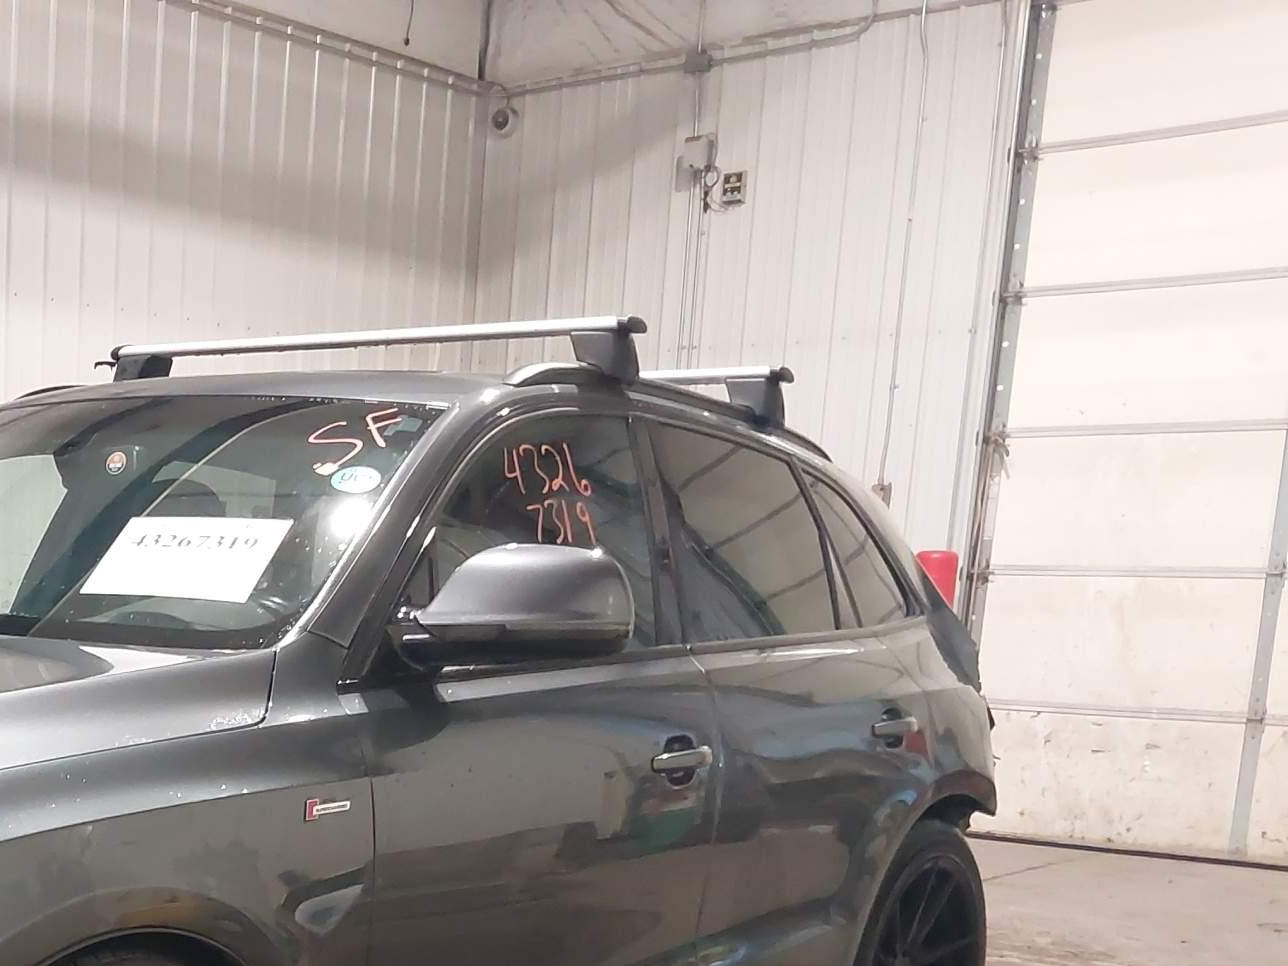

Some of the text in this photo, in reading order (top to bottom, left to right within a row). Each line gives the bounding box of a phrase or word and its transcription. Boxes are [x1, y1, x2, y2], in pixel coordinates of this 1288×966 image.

[307, 407, 402, 476] SF
[503, 442, 592, 497] 4326
[132, 533, 260, 550] 43267319
[525, 499, 597, 545] 7319
